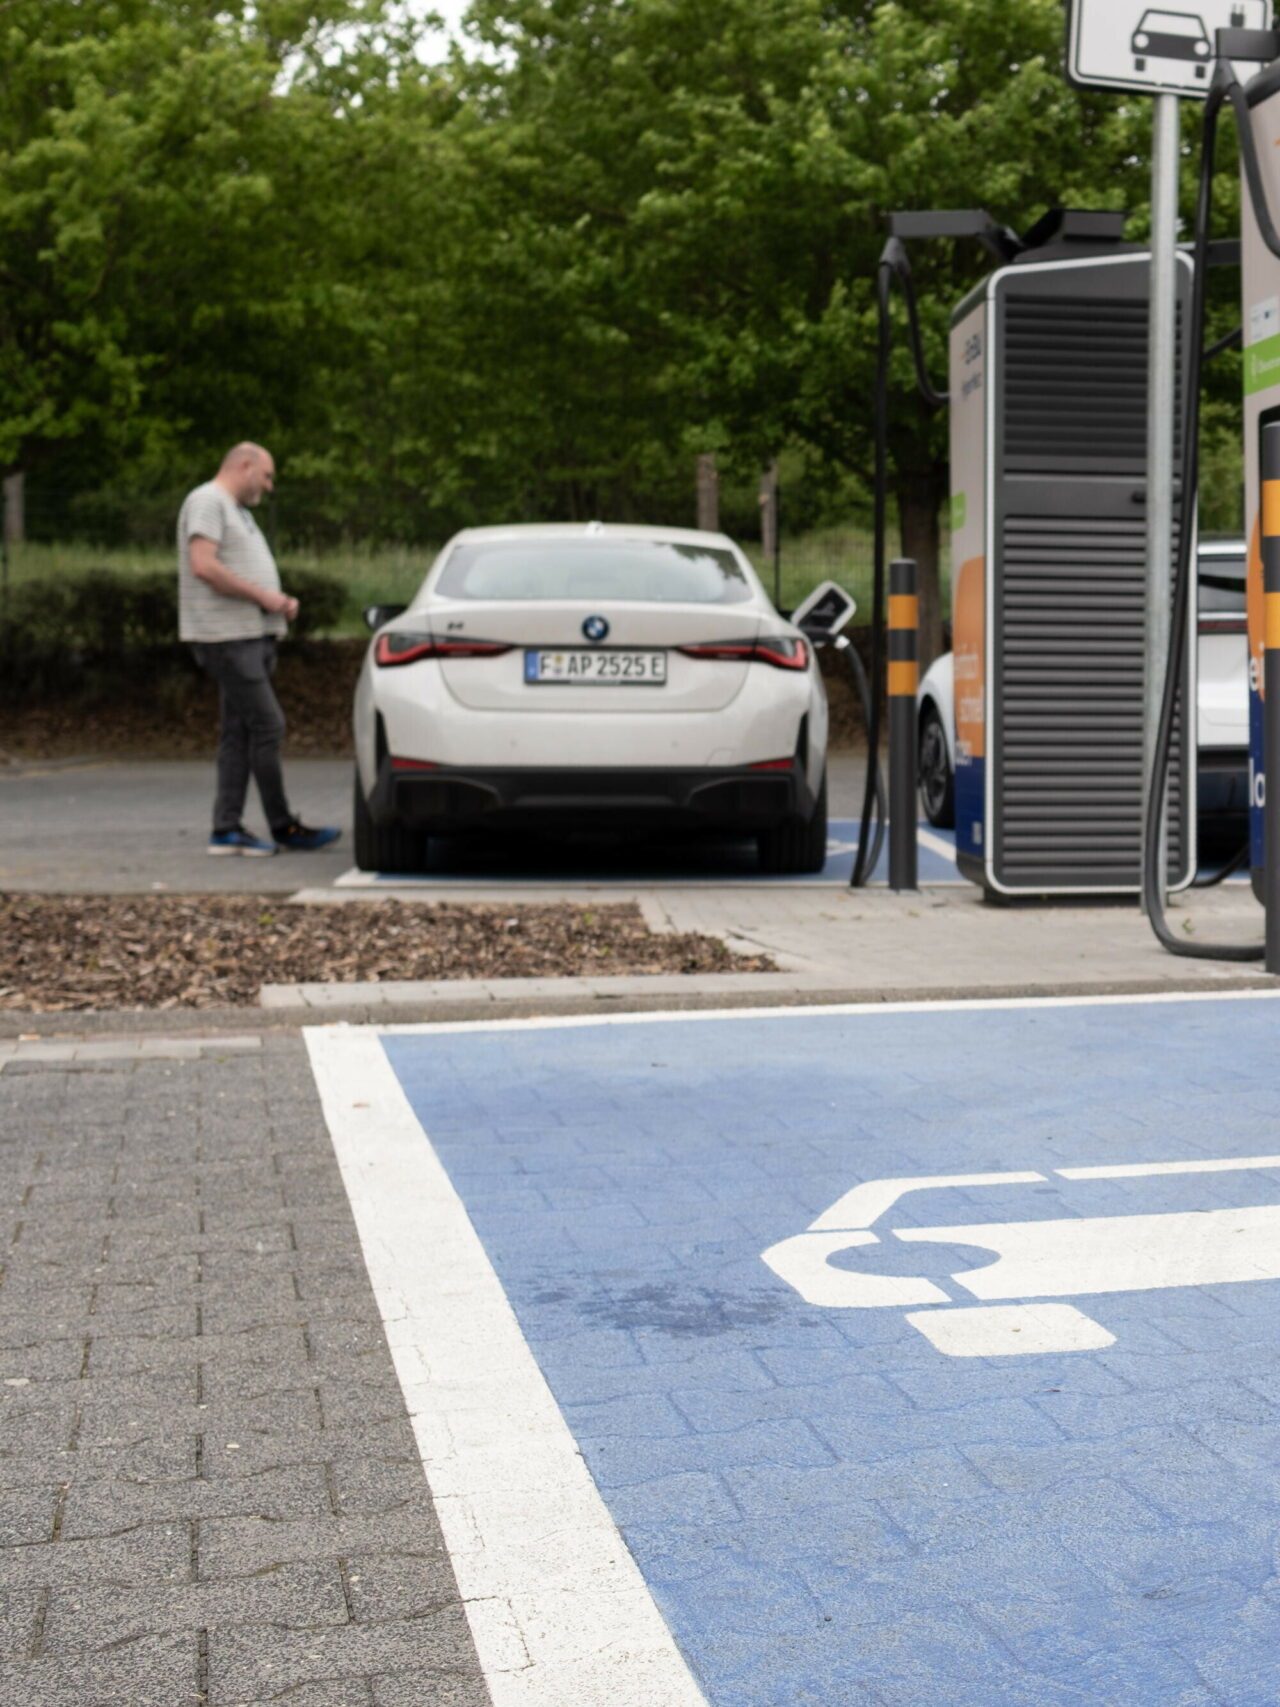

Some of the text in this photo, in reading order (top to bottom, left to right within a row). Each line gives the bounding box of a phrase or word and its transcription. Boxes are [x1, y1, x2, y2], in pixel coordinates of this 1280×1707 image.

[540, 655, 664, 676] F AP 2525 E
